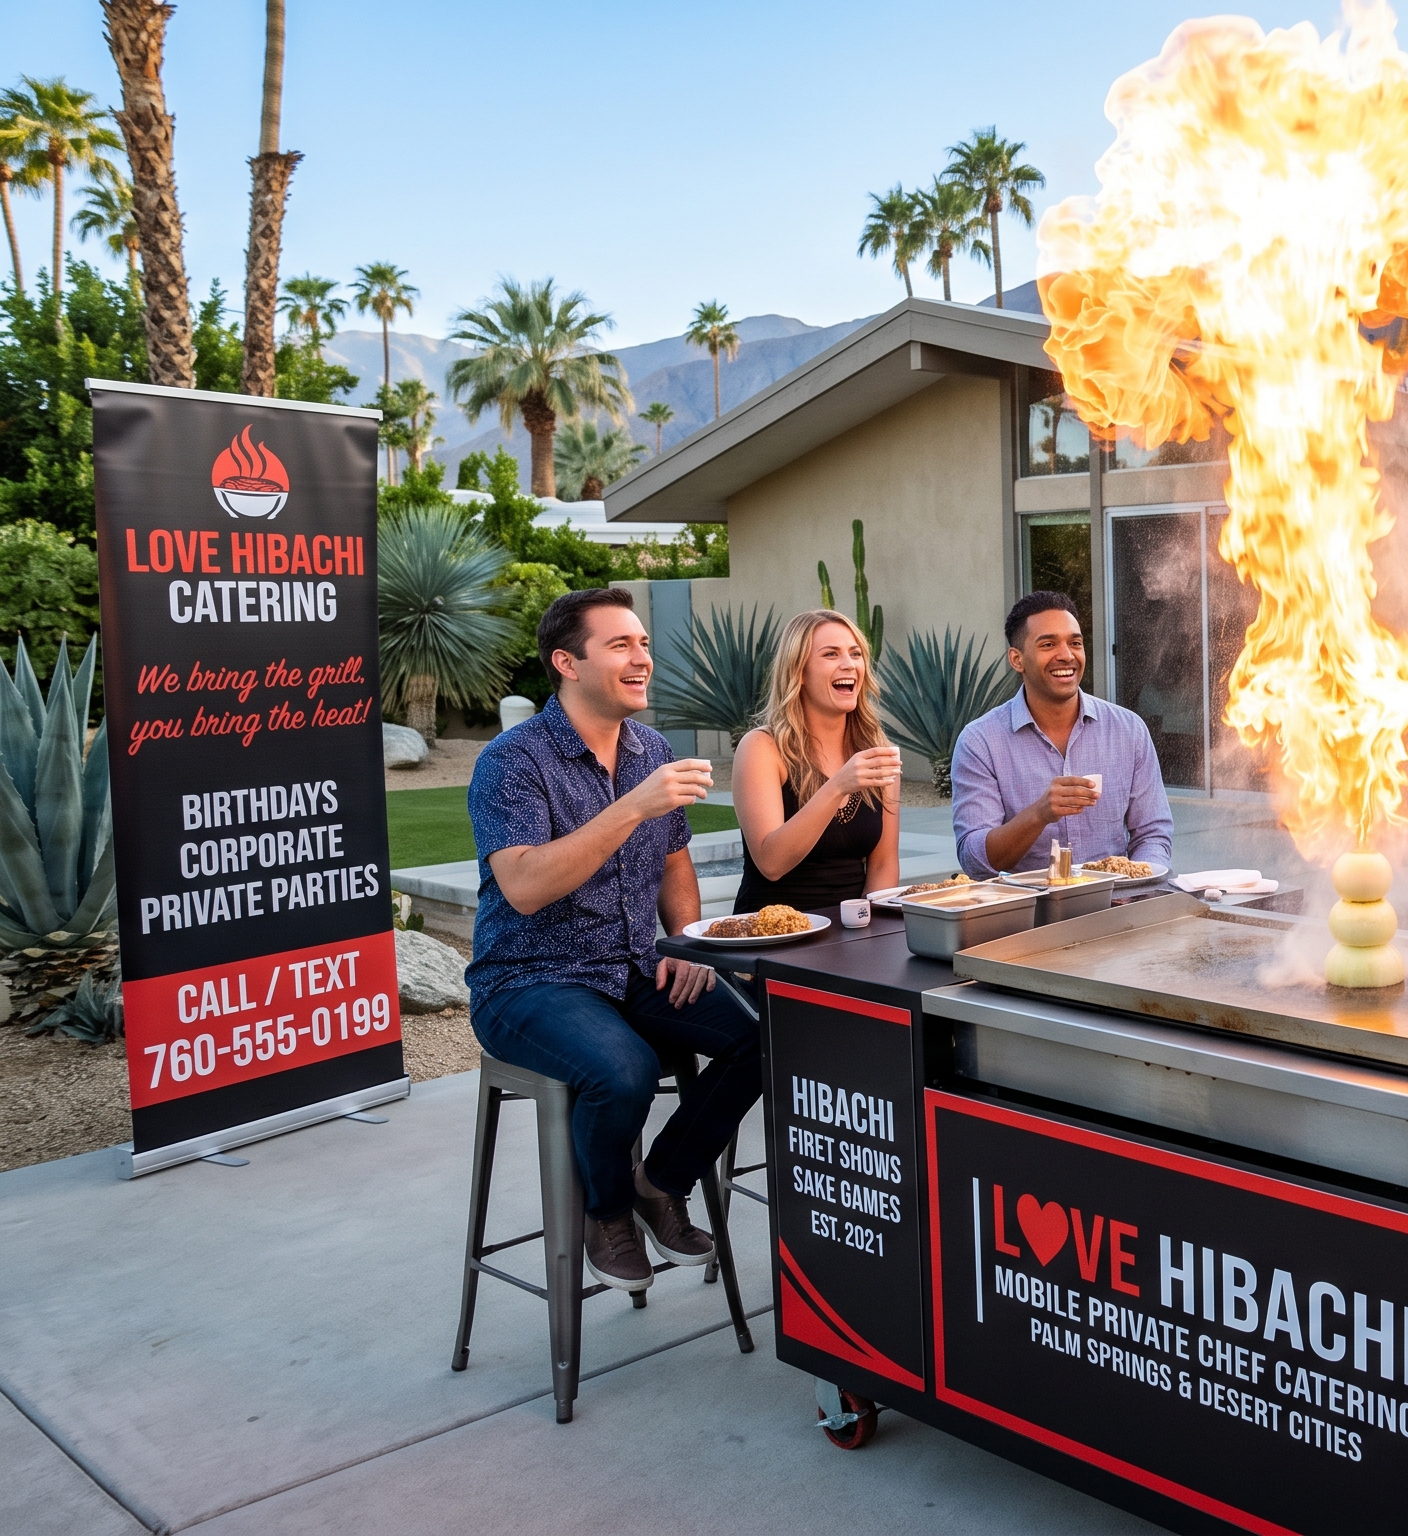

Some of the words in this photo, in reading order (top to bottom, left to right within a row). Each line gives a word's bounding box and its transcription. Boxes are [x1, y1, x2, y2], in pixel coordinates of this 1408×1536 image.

[126, 529, 220, 573] LOVE
[231, 532, 364, 575] HIBACHI
[169, 580, 336, 623] CATERING
[138, 664, 180, 694] We
[187, 661, 258, 702] bring
[265, 659, 302, 687] the
[308, 657, 364, 699] grill,
[129, 719, 183, 755] you
[191, 700, 261, 746] bring
[268, 701, 305, 730] the
[310, 697, 372, 726] heat!
[183, 780, 338, 830] BIRTHDAYS
[181, 824, 344, 878] CORPORATE
[141, 881, 264, 934] PRIVATE
[272, 864, 378, 912] PARTIES
[178, 974, 256, 1023] CALL
[265, 967, 280, 1005] /
[289, 951, 359, 998] TEXT
[145, 993, 389, 1088] 760-555-0199
[793, 1076, 894, 1142] HIBACHI
[789, 1126, 834, 1163] FIRET
[840, 1141, 901, 1183] SHOWS
[793, 1166, 836, 1203] SAKE
[841, 1180, 900, 1223] GAMES
[812, 1210, 840, 1242] EST.
[845, 1222, 883, 1256] 2021
[996, 1265, 1080, 1322] MOBILE
[1089, 1297, 1189, 1360] PRIVATE
[1199, 1335, 1265, 1384] CHEF
[1031, 1318, 1080, 1358] PALM
[1088, 1338, 1171, 1391] SPRINGS
[1179, 1372, 1192, 1399] &
[1200, 1378, 1281, 1431] DESERT
[1290, 1411, 1361, 1461] CITIES
